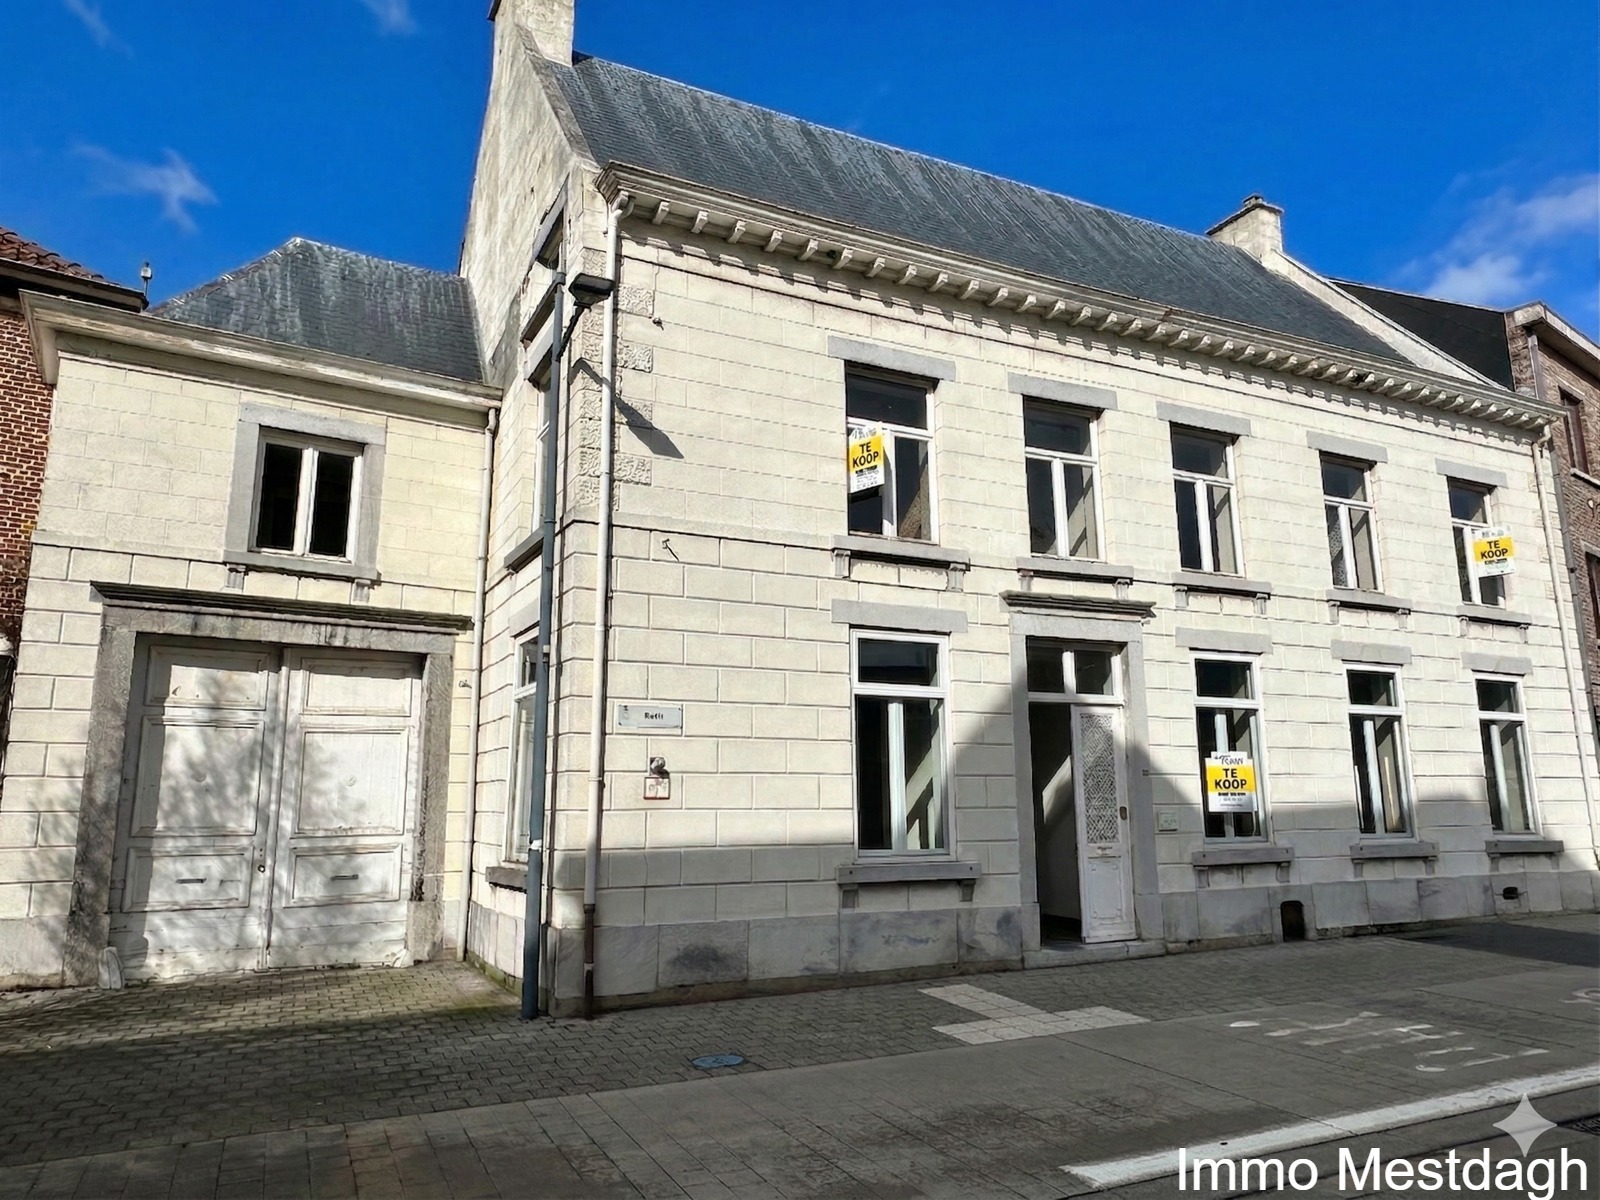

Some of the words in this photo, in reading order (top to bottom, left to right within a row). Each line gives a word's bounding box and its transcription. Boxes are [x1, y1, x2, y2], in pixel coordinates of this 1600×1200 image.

[859, 441, 872, 455] TE
[852, 451, 879, 469] KOOP
[1487, 540, 1500, 549] TE
[1480, 548, 1508, 559] KOOP
[1222, 768, 1238, 778] TE
[1214, 779, 1247, 790] KOOP
